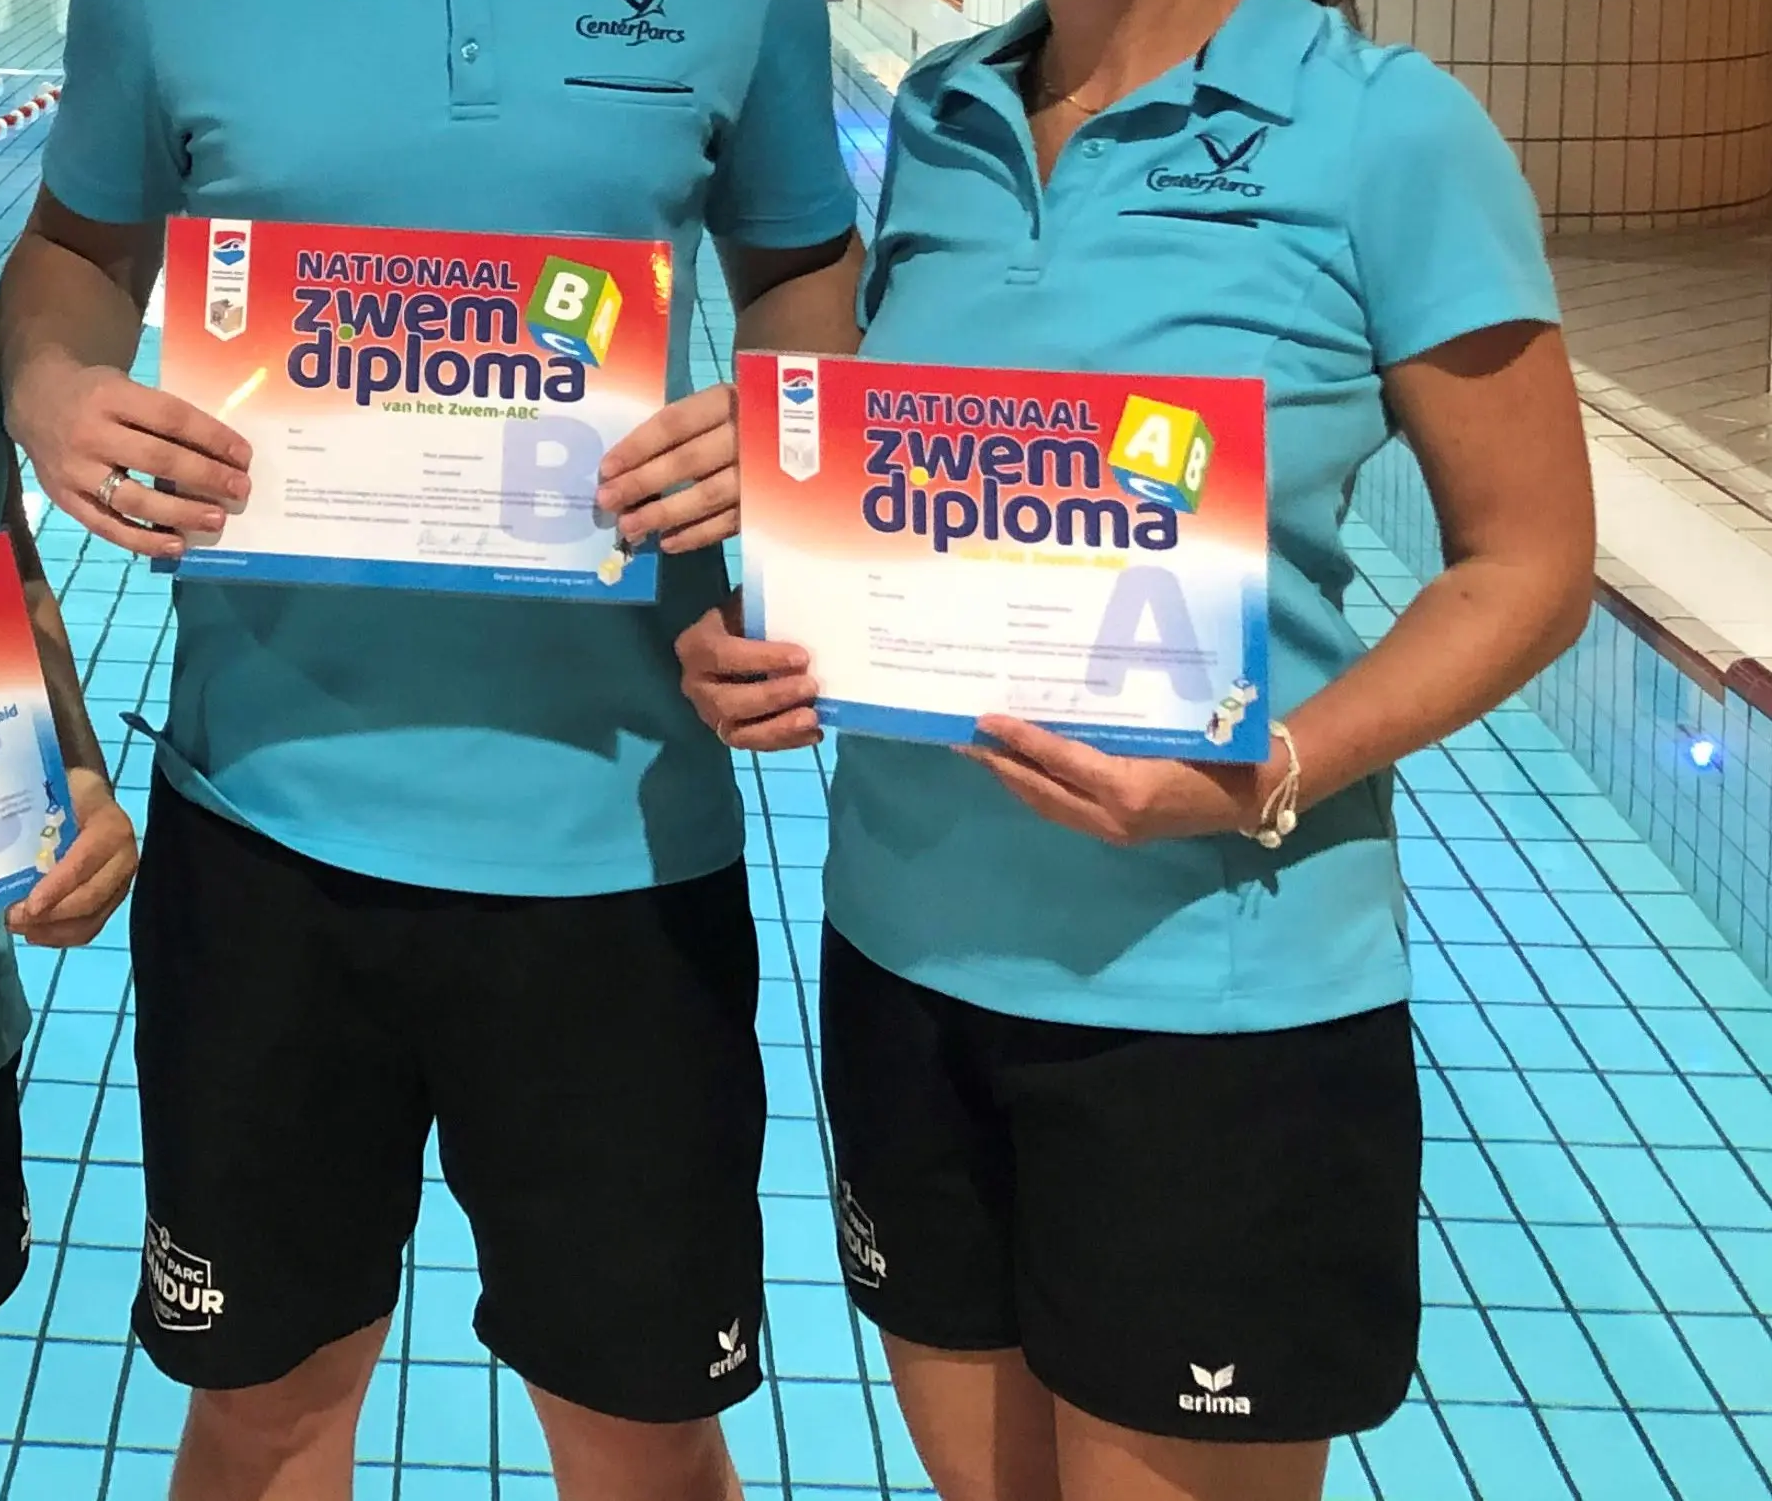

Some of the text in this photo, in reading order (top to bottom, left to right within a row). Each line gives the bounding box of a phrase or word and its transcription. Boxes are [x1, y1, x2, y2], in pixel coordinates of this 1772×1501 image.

[297, 251, 519, 291] NATIONAAL
[543, 271, 590, 322] B
[293, 288, 518, 345] zwem
[287, 327, 586, 406] diploma
[381, 400, 540, 420] van het Zwem-ABC
[866, 390, 1099, 432] NATIONAAL
[865, 428, 1101, 490] zwem
[1124, 414, 1172, 468] A
[862, 471, 1179, 553] diploma
[167, 1257, 205, 1284] PARC
[1178, 1391, 1252, 1415] erima
